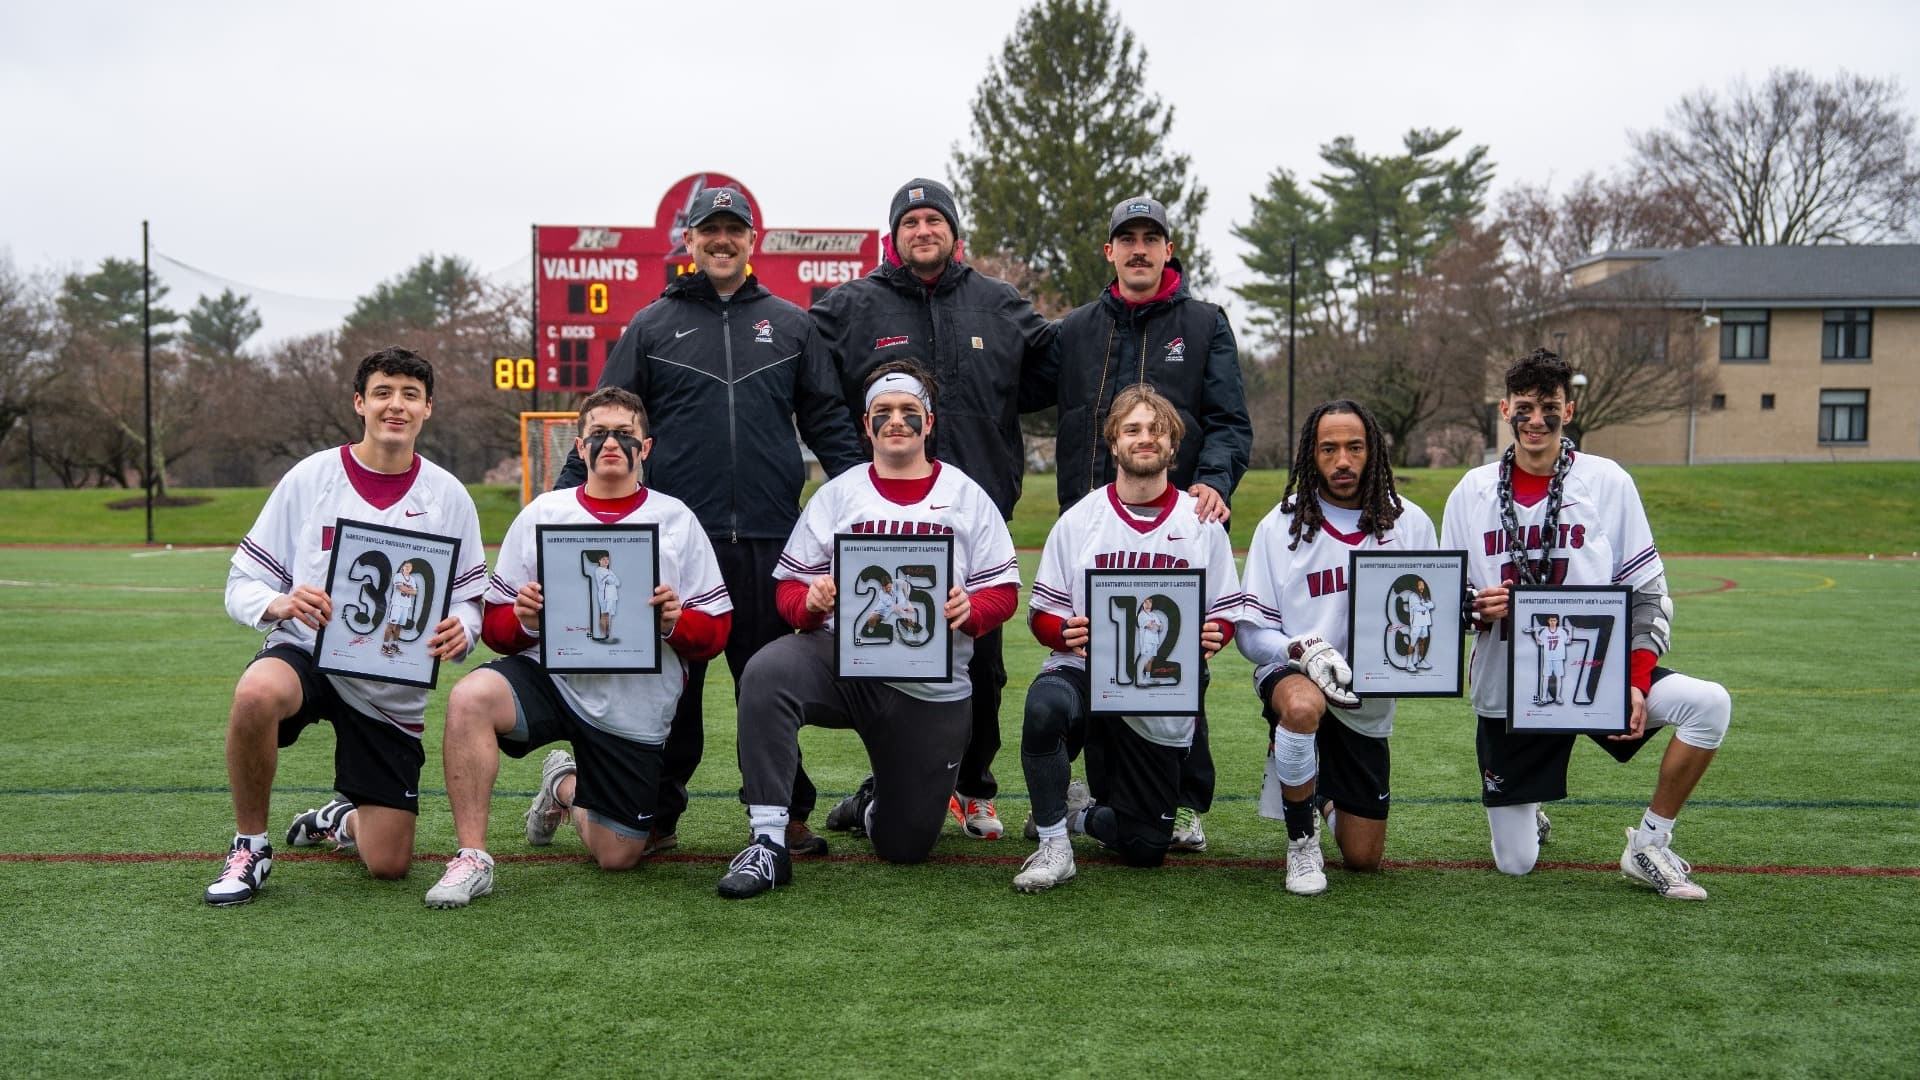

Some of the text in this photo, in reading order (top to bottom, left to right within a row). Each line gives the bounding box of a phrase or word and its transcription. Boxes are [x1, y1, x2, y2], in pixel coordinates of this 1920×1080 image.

[543, 258, 638, 281] VALIANTS
[798, 261, 863, 282] GUEST
[589, 283, 608, 313] 0
[561, 326, 595, 338] KICKS
[547, 343, 556, 357] 1
[495, 359, 535, 389] 80
[547, 367, 558, 382] 2
[1306, 566, 1347, 598] VAL
